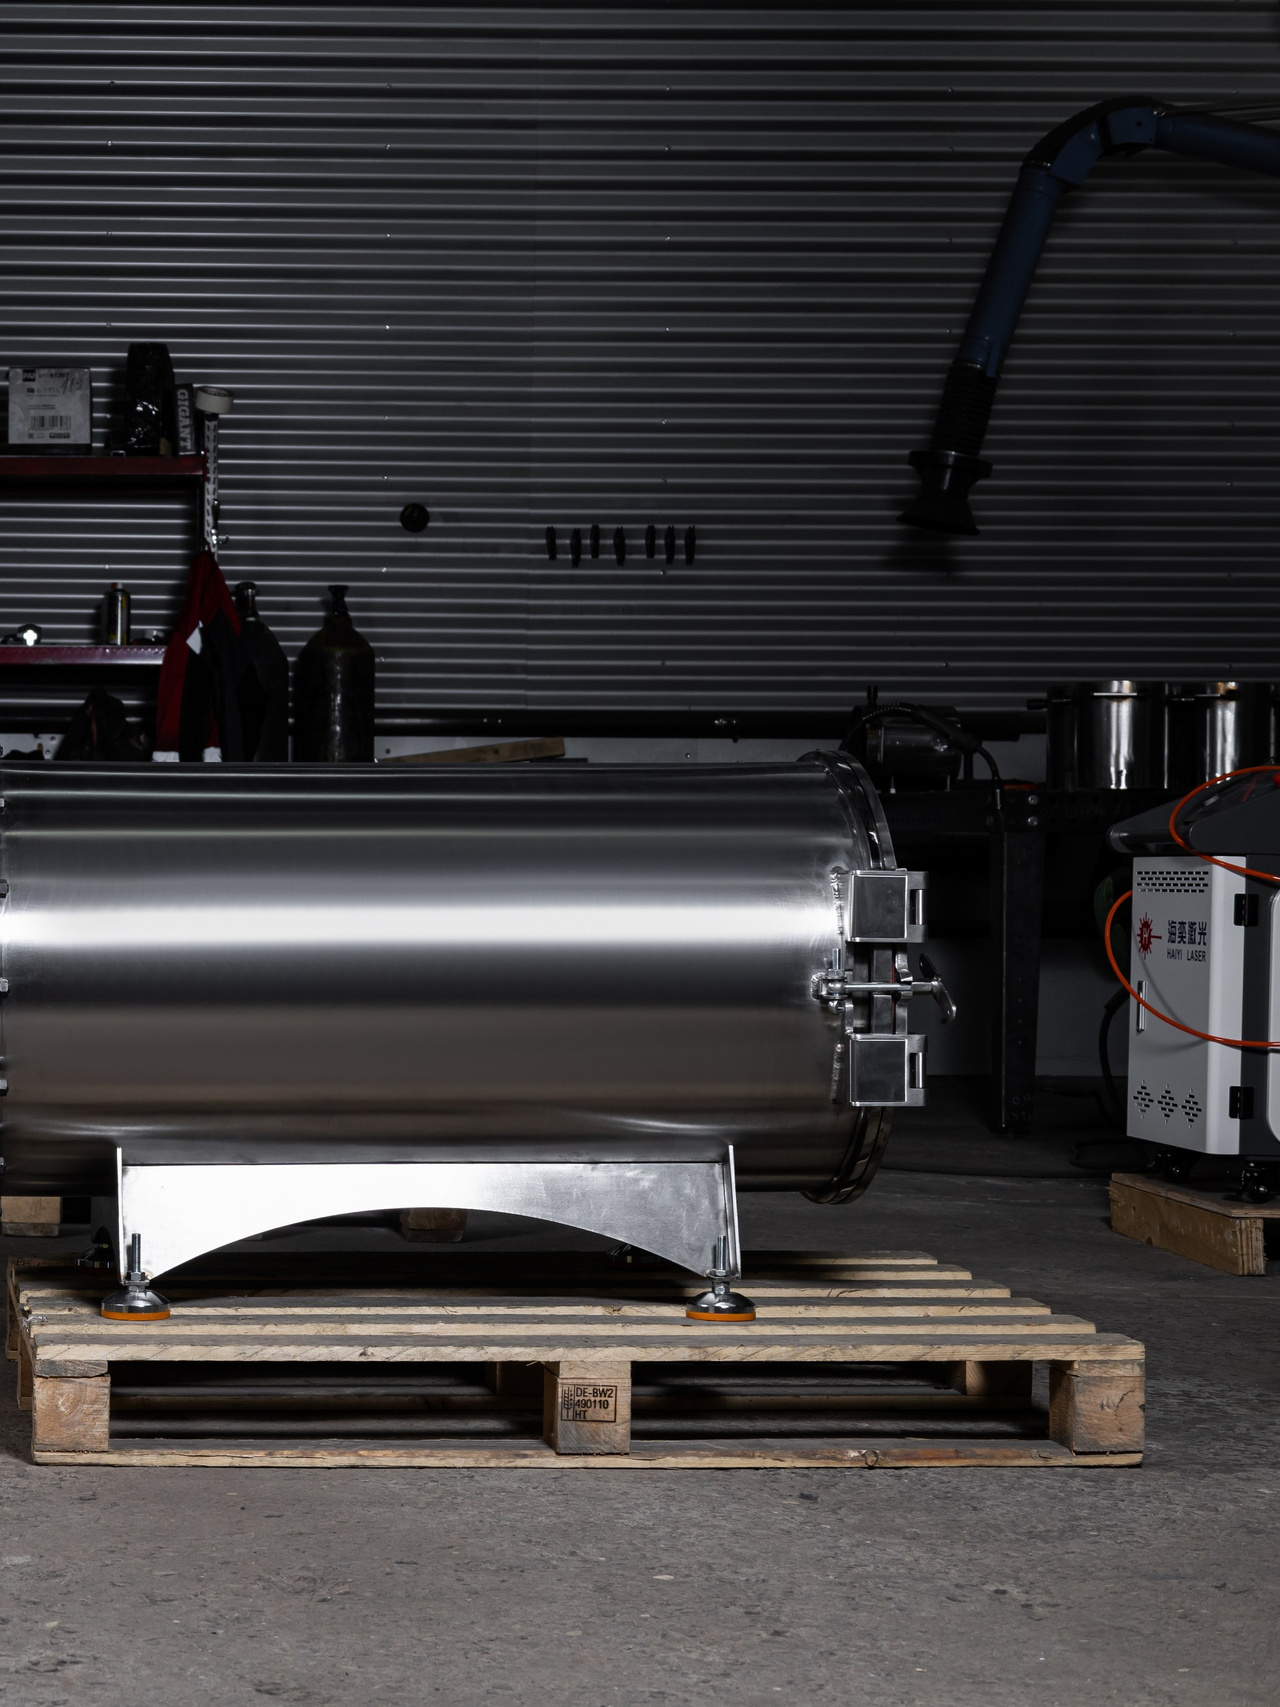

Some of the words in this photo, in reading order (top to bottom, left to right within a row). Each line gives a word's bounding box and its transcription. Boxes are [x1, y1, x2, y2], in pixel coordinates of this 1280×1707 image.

[177, 388, 192, 450] GIGANT
[1167, 948, 1183, 960] HAIYI
[1187, 949, 1207, 962] LASER
[576, 1387, 614, 1398] DE-BW2
[575, 1399, 609, 1409] 490110
[575, 1410, 588, 1419] HT
